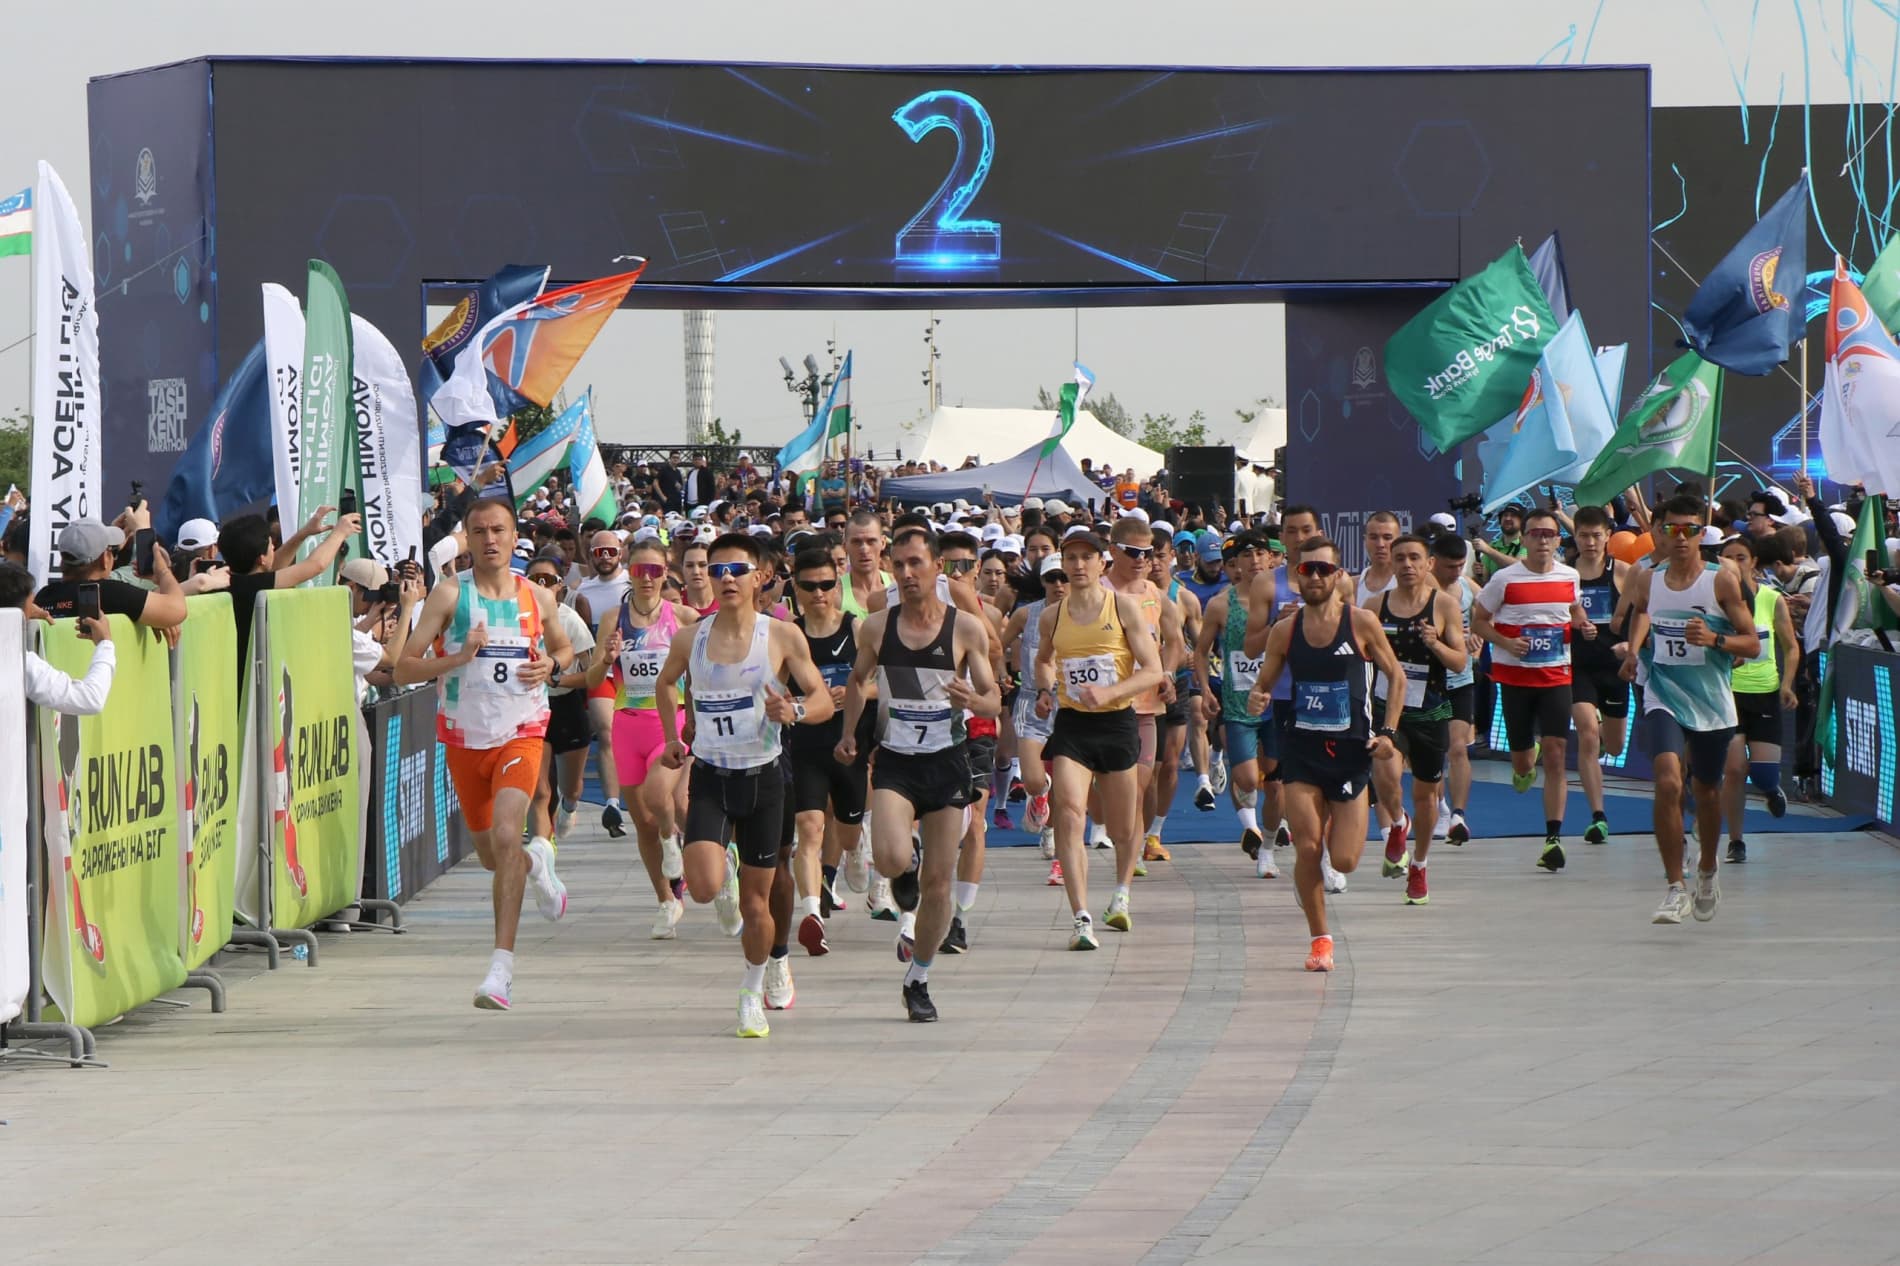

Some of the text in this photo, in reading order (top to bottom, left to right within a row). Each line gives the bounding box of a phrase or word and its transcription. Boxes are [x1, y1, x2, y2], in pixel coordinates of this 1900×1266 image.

[892, 90, 1000, 262] 2
[148, 384, 187, 419] TASH
[148, 413, 184, 442] KENT
[1666, 640, 1687, 657] 13
[493, 662, 508, 684] 8
[630, 663, 659, 677] 685
[1070, 668, 1099, 685] 530
[1305, 695, 1325, 711] 74
[712, 716, 735, 736] 11
[914, 725, 927, 744] 7
[298, 715, 349, 791] RUN LAB
[88, 744, 165, 834] RUN LAB
[81, 838, 128, 880] ЗАРЯЖЕНЫ
[130, 833, 144, 866] НА
[145, 827, 166, 861] БЕГ
